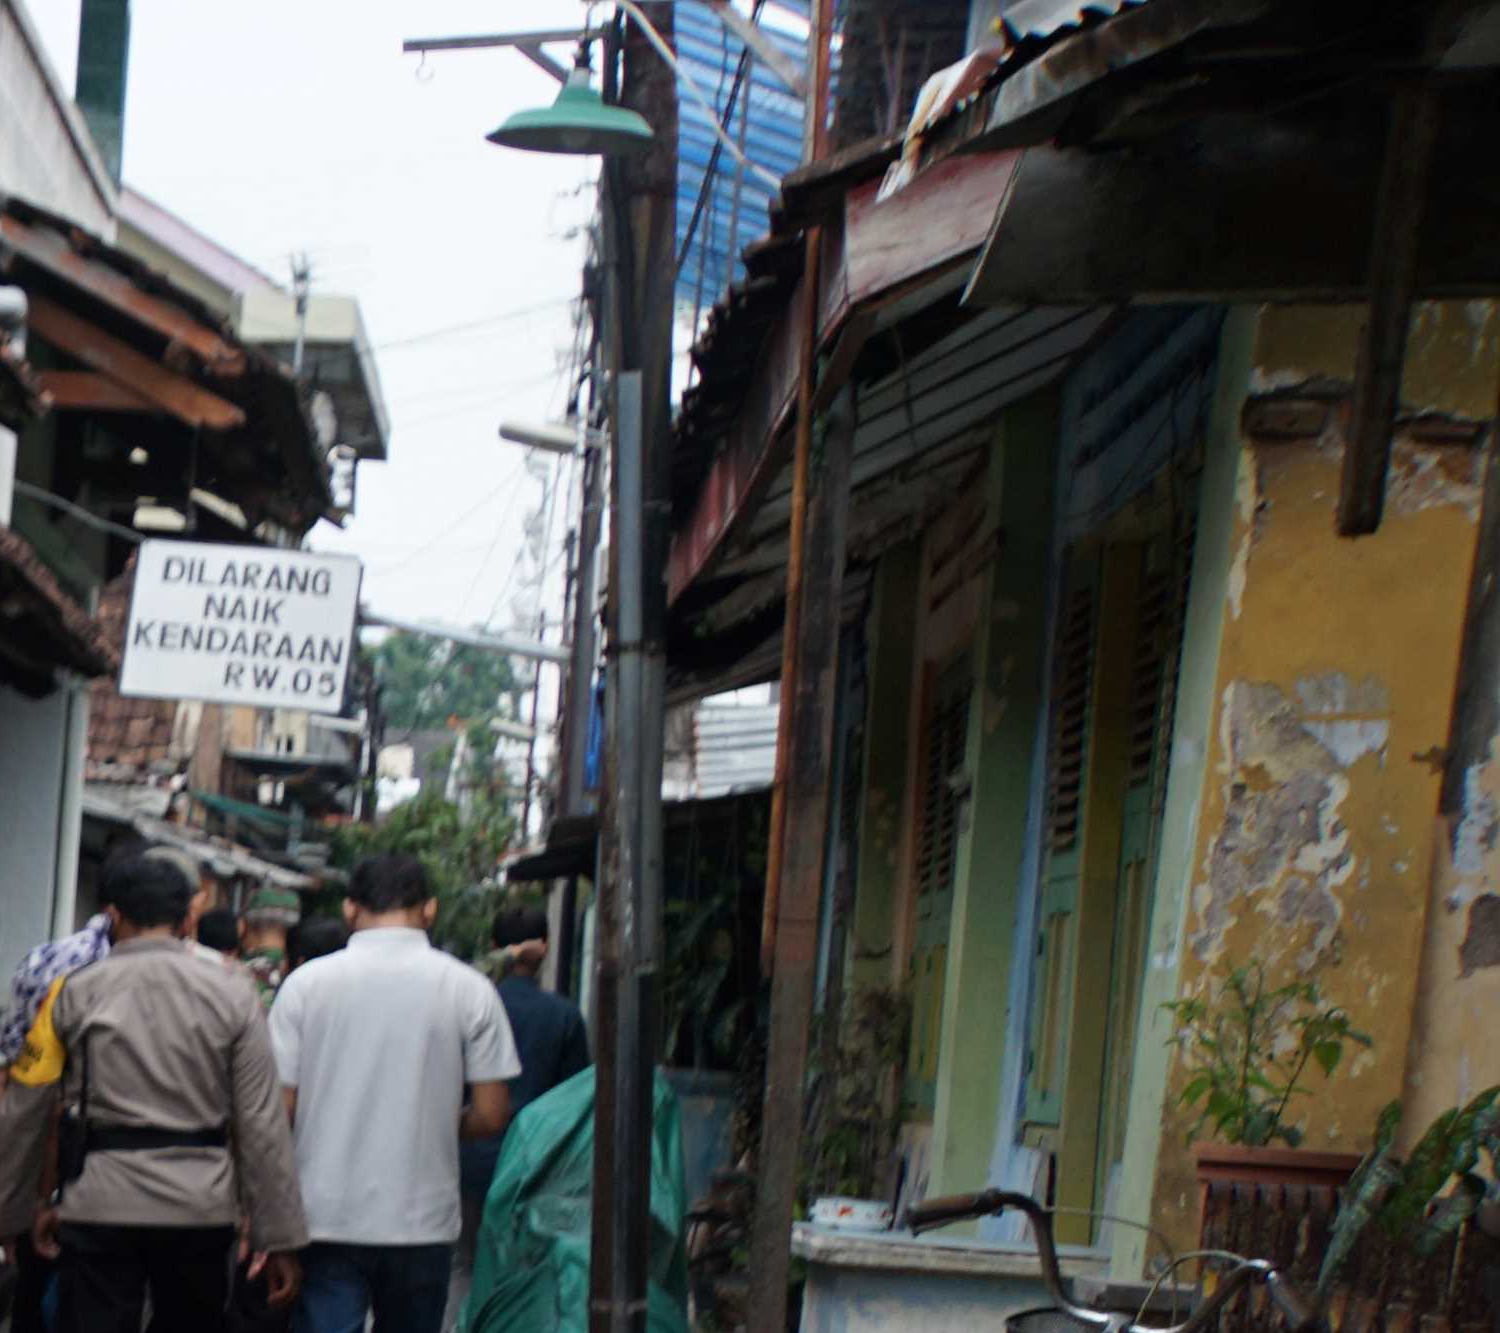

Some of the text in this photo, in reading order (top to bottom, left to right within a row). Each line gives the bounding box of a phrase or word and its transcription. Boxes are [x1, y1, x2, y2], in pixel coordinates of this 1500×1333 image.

[161, 555, 332, 597] DILARANG
[203, 595, 285, 625] NAIK
[133, 620, 344, 665] KENDARAAN
